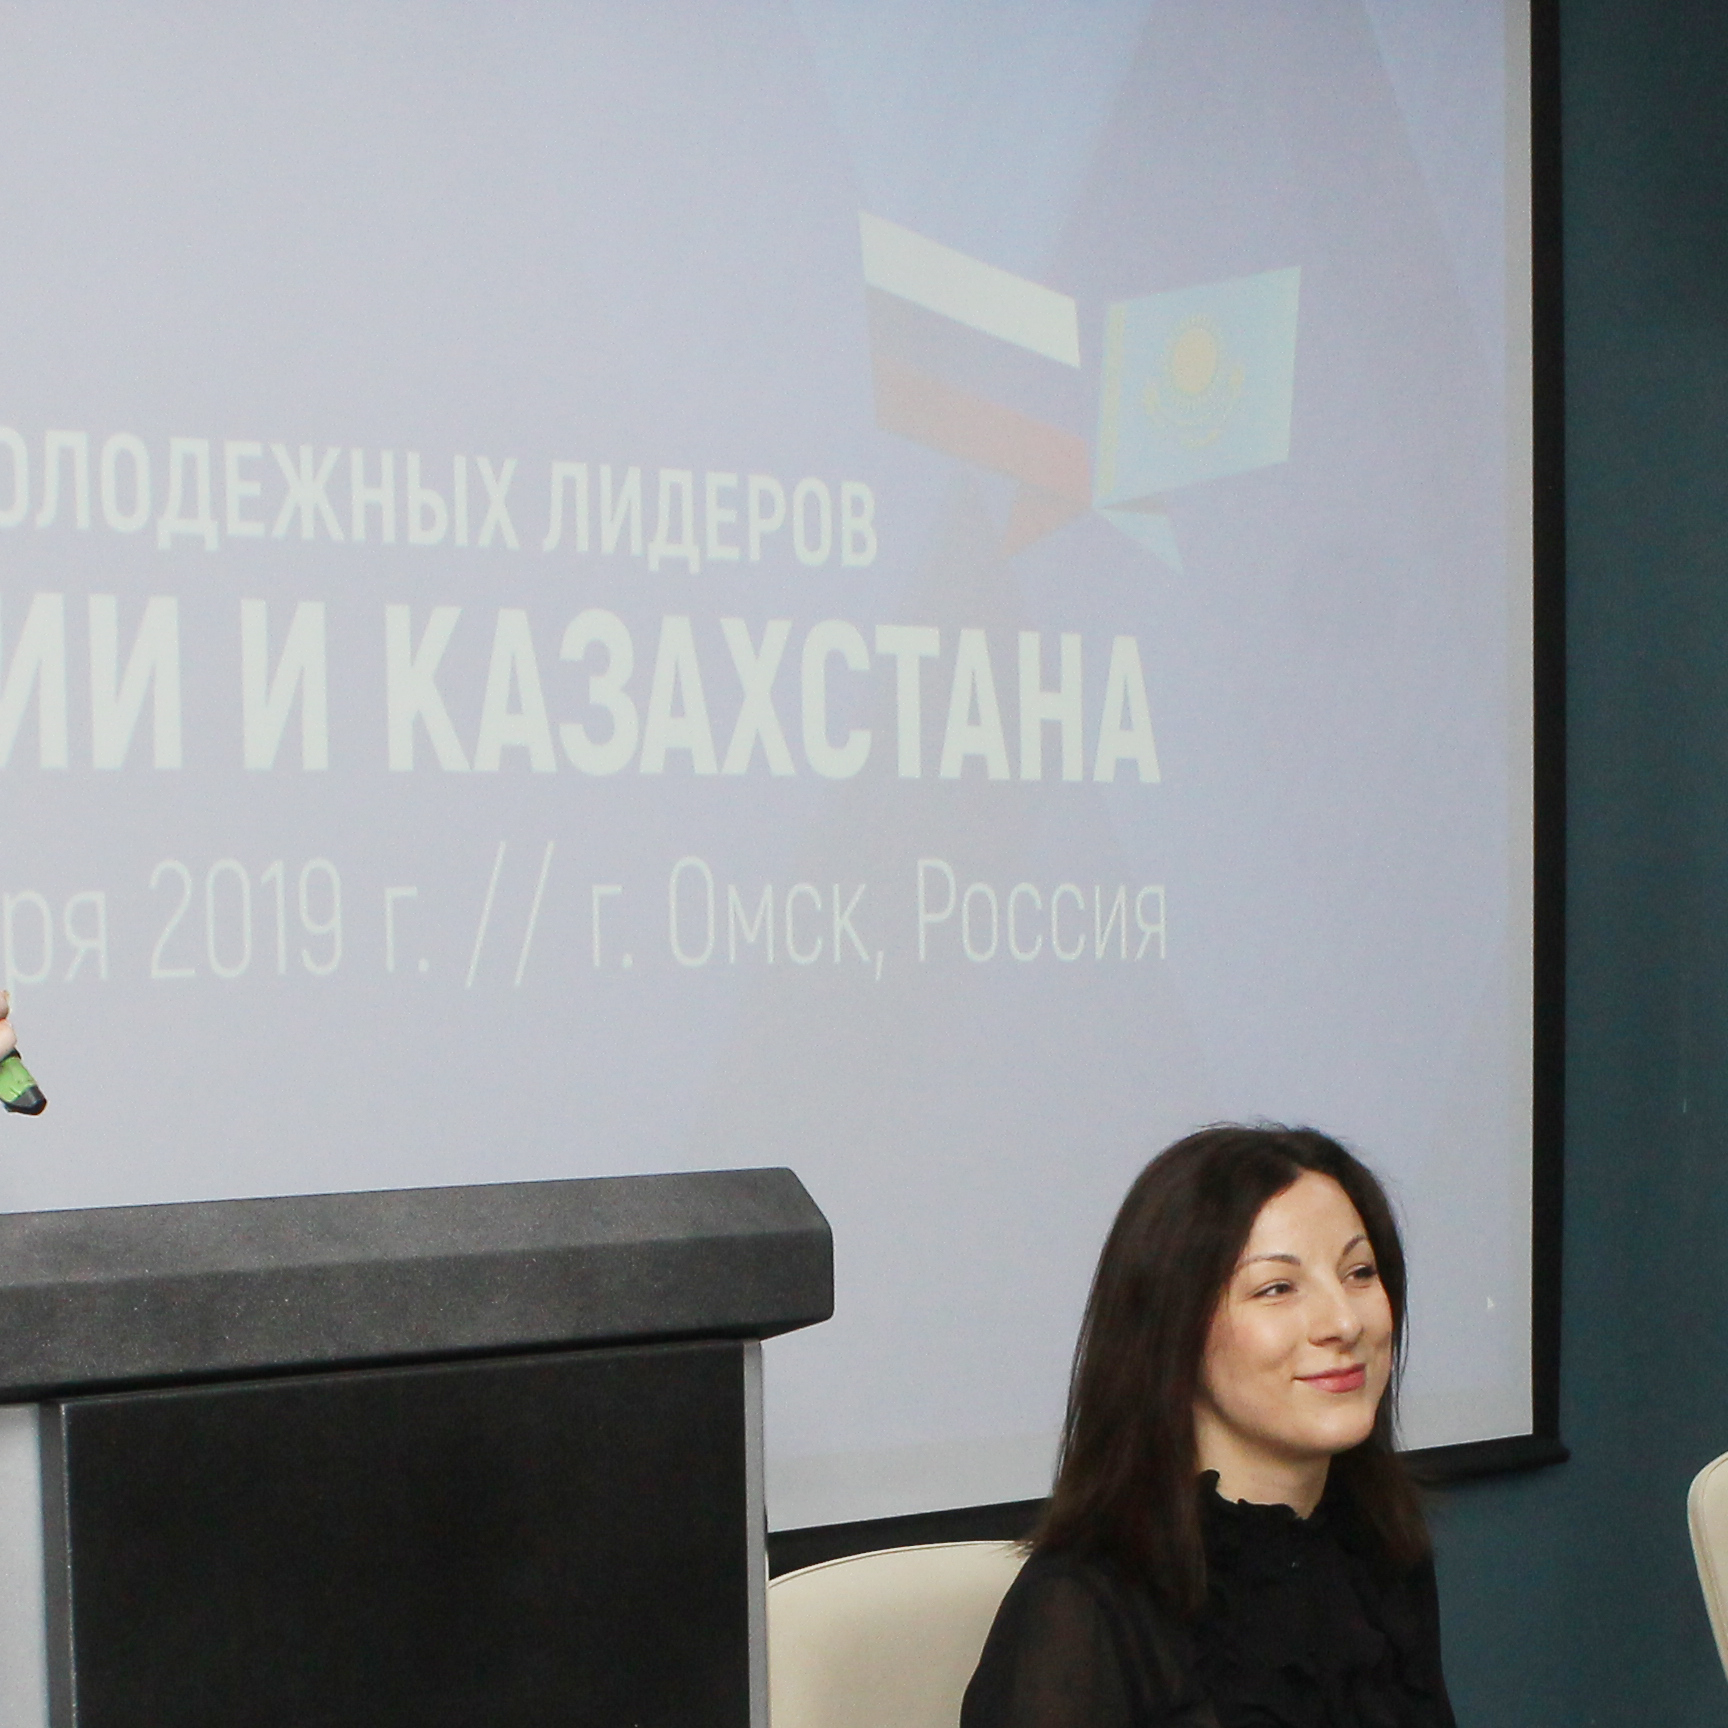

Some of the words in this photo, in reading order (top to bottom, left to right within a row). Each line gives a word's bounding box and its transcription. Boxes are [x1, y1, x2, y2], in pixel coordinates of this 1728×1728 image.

[542, 459, 878, 574] ЛИДЕРОВ
[240, 598, 329, 772] И
[384, 603, 1162, 784] КАЗАХСТАНА
[148, 857, 344, 979] 2019
[383, 885, 429, 973] г.
[591, 883, 634, 968] г.
[670, 855, 884, 982] Омск,
[916, 858, 1167, 963] Россия
